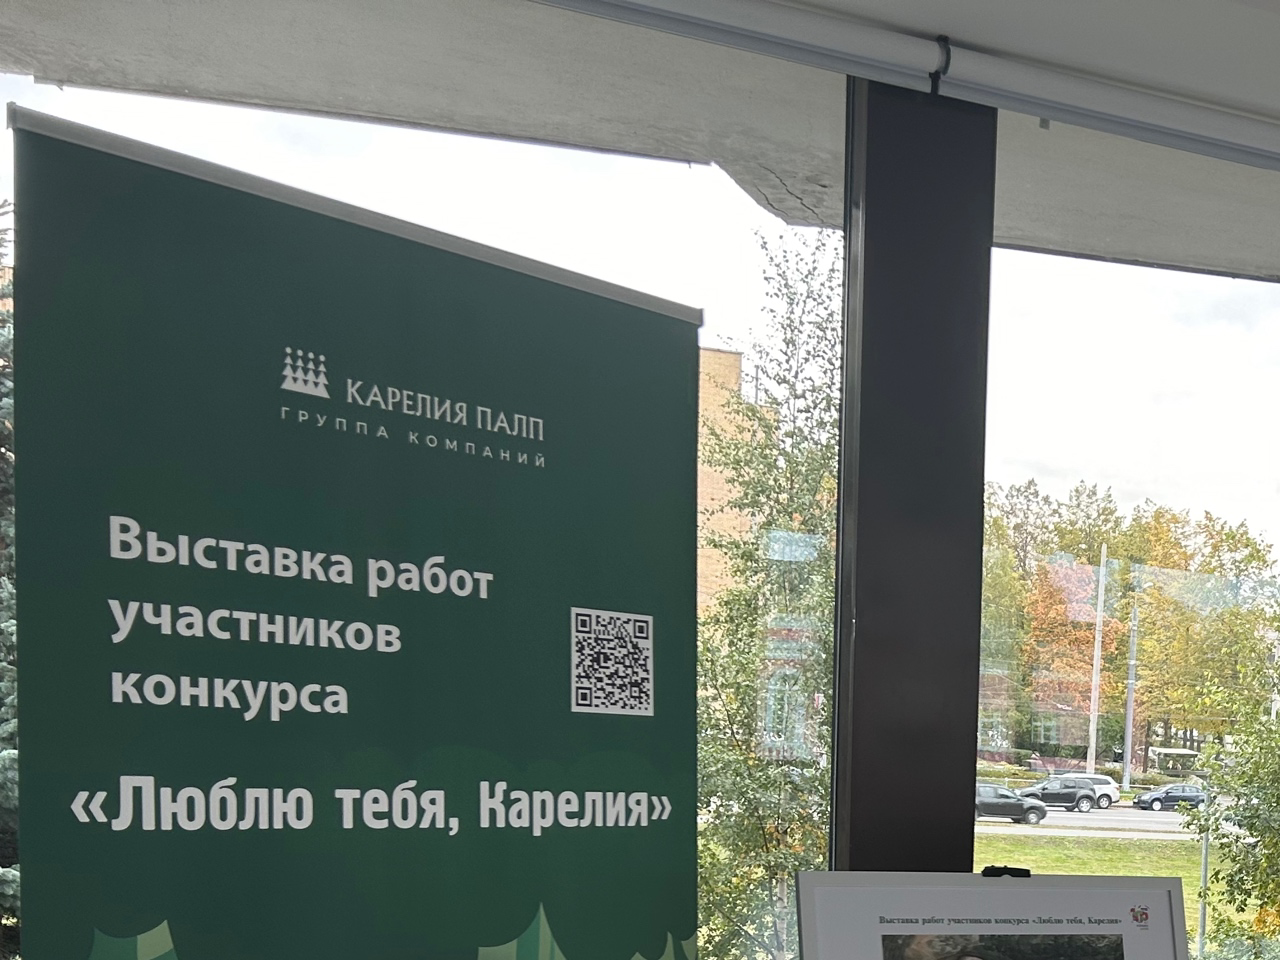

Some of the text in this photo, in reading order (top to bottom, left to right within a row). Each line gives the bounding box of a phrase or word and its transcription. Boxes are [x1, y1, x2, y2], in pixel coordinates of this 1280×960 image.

[280, 406, 546, 468] ГРУППА КОМПАНИЙ
[346, 378, 545, 442] КАРЕЛИЯ ПАЛП
[109, 515, 494, 599] Выставка работ
[107, 598, 403, 653] участников
[111, 671, 349, 721] конкурса
[70, 774, 673, 836] «Люблю тебя, Карелия»
[878, 915, 920, 925] Выставка
[922, 915, 945, 926] работ
[947, 916, 993, 926] участников
[994, 916, 1030, 926] конкурса
